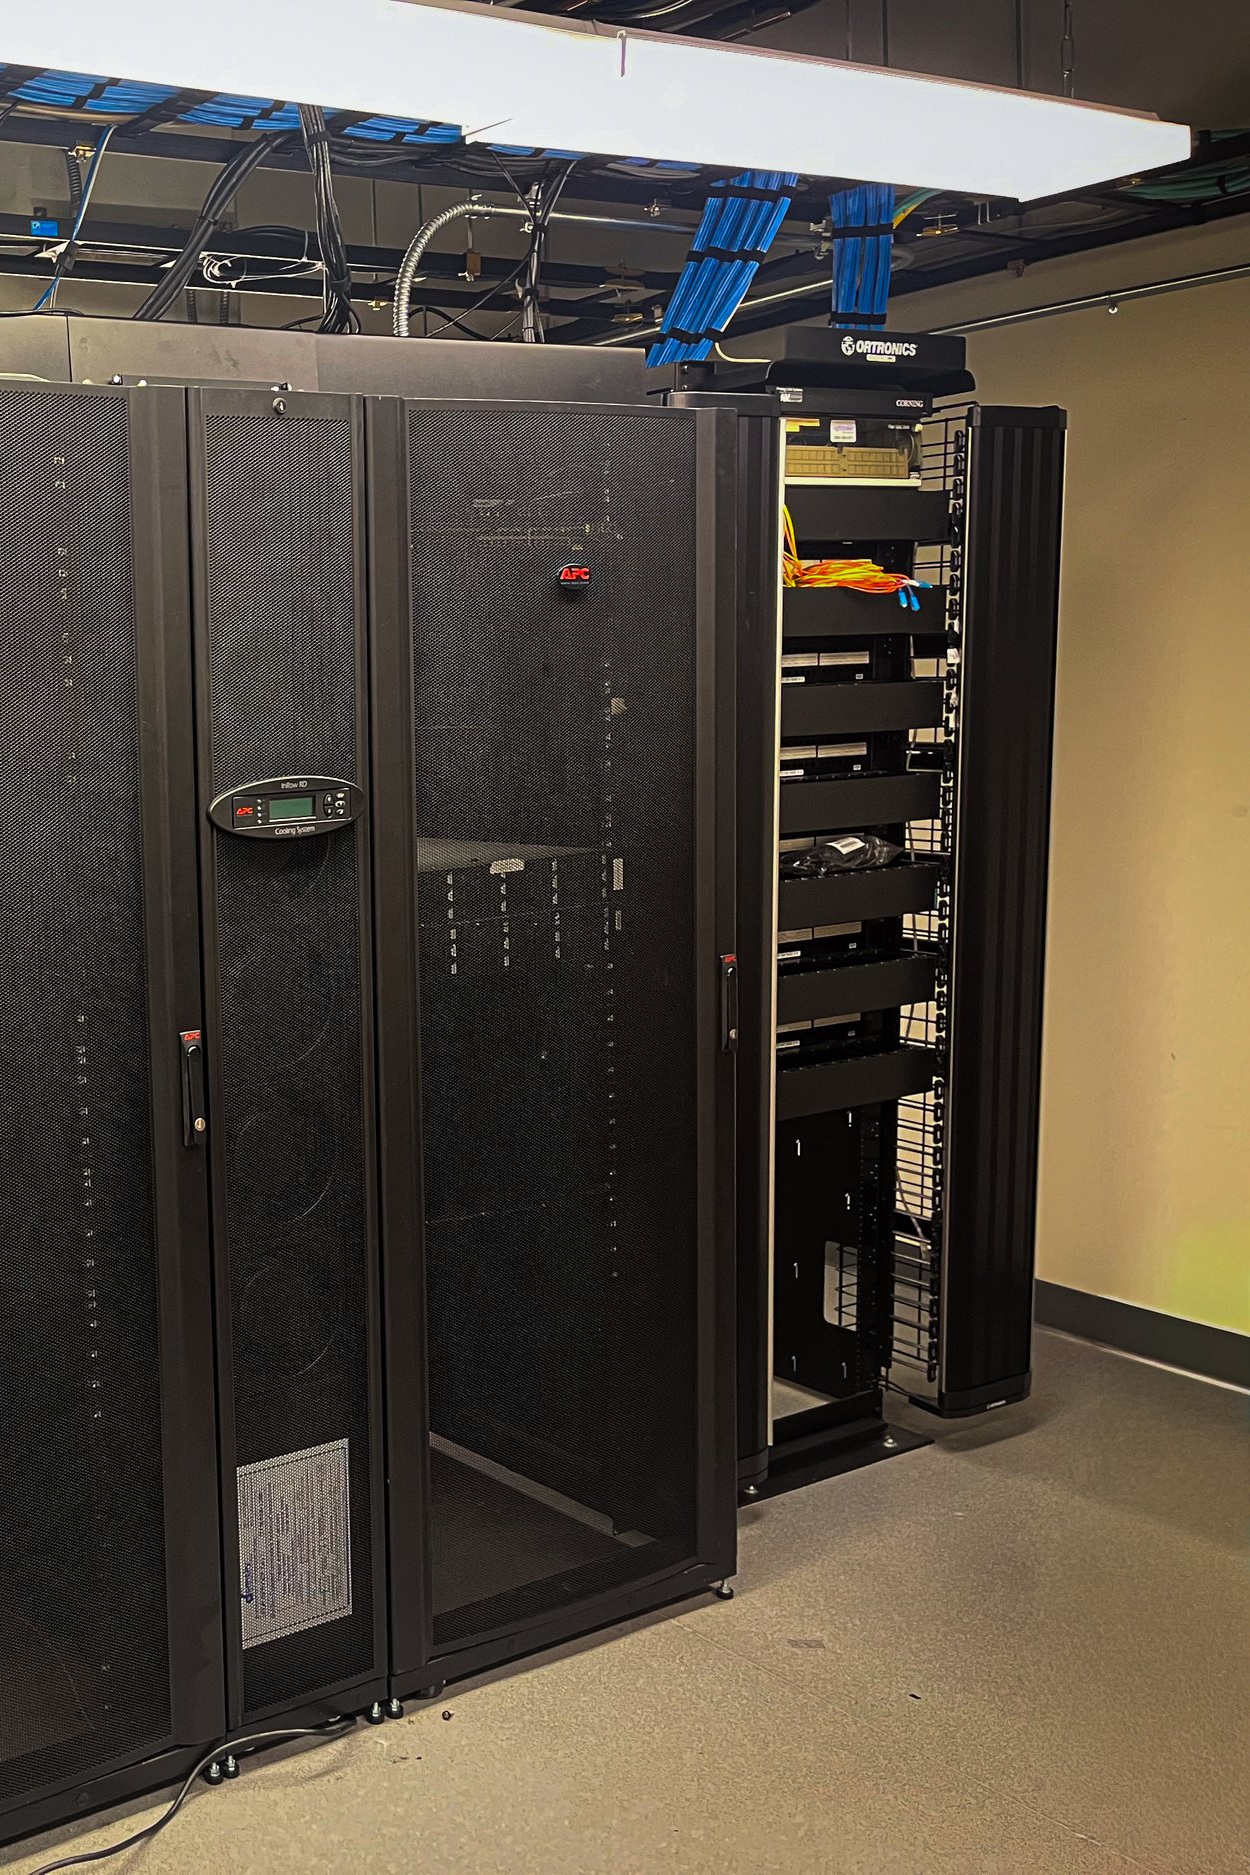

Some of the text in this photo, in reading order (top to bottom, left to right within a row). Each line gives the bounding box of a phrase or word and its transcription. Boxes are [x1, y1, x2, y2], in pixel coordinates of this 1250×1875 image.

[855, 339, 917, 356] ORTRONICS
[895, 399, 924, 409] CORNING
[559, 567, 590, 580] APC
[236, 806, 254, 816] APC
[274, 827, 296, 836] Cooling
